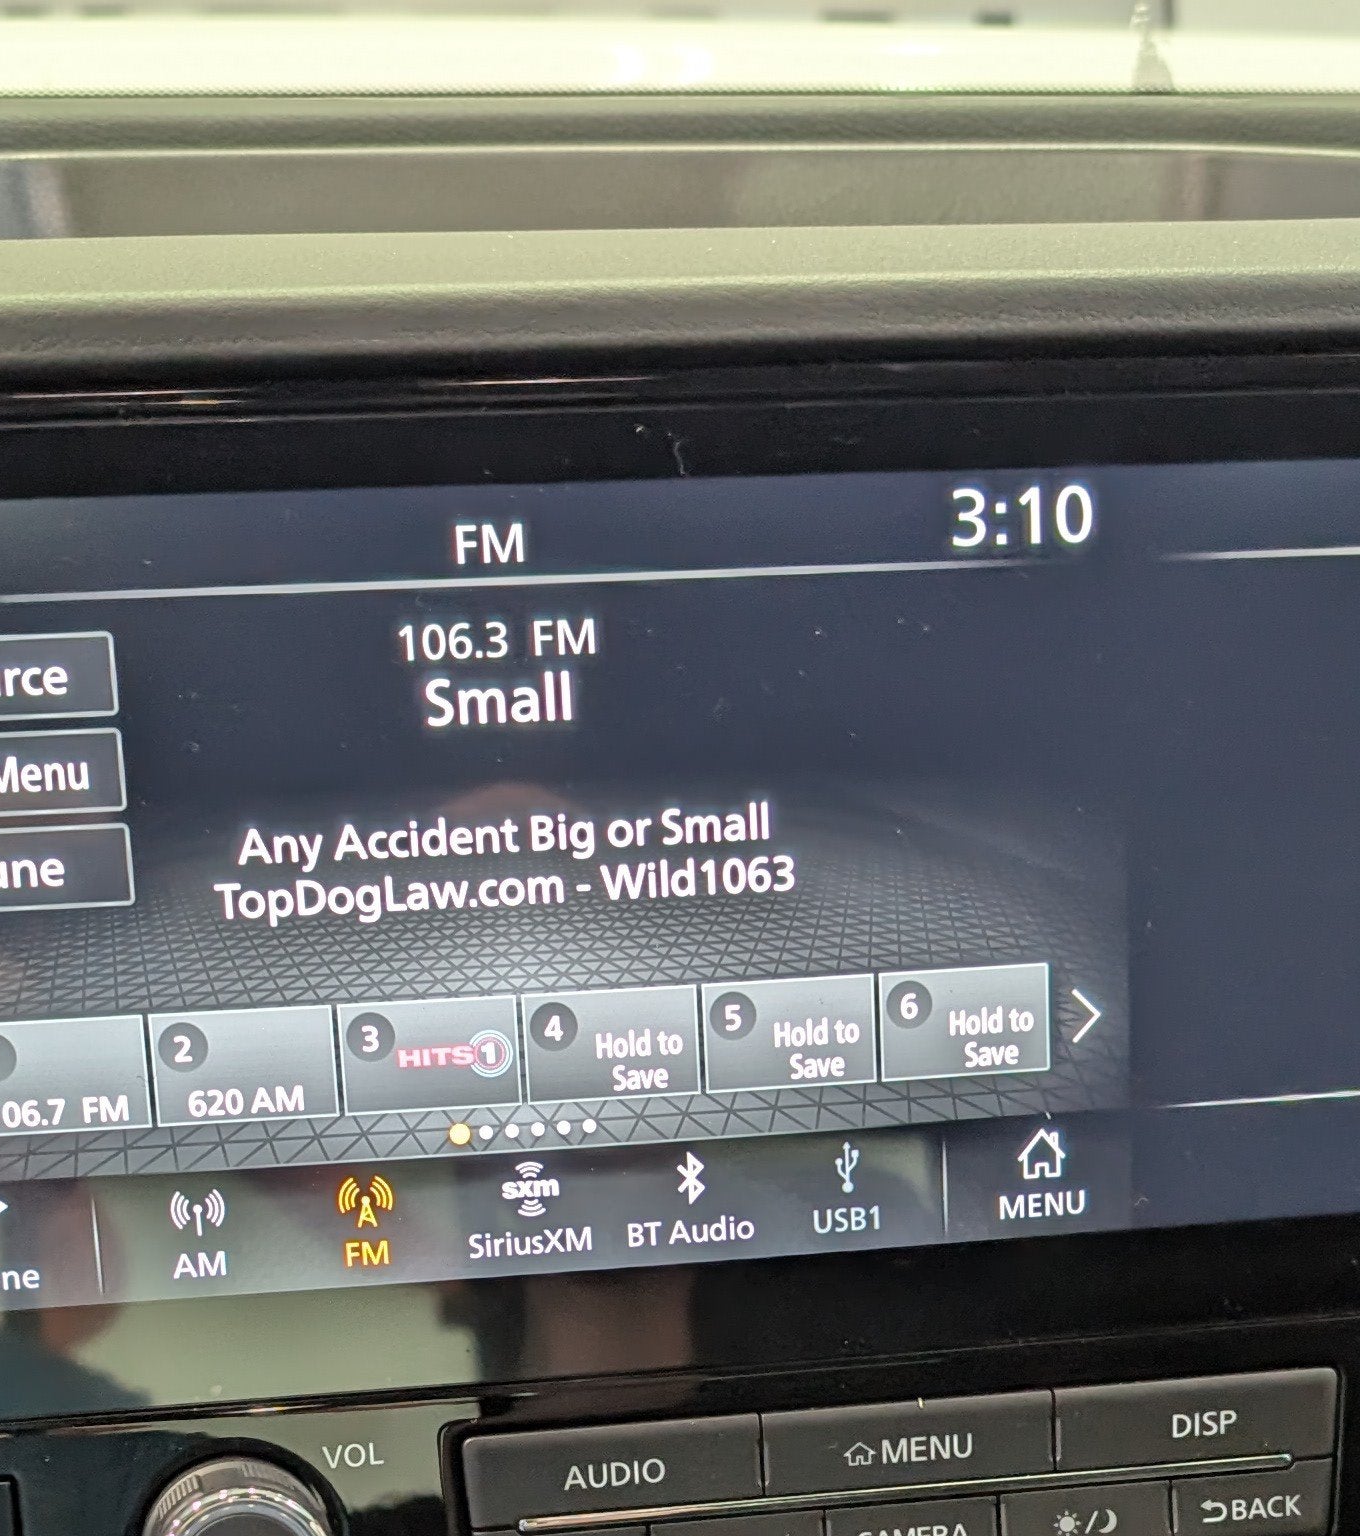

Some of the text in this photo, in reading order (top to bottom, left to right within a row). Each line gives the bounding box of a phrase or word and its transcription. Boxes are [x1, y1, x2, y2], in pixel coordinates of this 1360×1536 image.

[951, 485, 1093, 548] 3:10
[455, 523, 526, 565] FM
[398, 618, 596, 662] 106.3 FM
[424, 670, 573, 727] Small
[238, 801, 770, 873] Any Accident Big or Small
[214, 855, 796, 926] TopDogLaw.com - Wild1063
[724, 1004, 742, 1032] 5
[900, 992, 918, 1020] 6
[544, 1015, 564, 1042] 4
[773, 1019, 860, 1049] Hold to
[948, 1008, 1035, 1037] Hold to
[172, 1036, 193, 1064] 2
[361, 1025, 380, 1053] 3
[595, 1031, 683, 1060] Hold to
[397, 1045, 476, 1068] HITS
[789, 1053, 845, 1080] Save
[964, 1041, 1019, 1068] Save
[612, 1064, 669, 1092] Save
[82, 1096, 131, 1124] FM
[188, 1085, 305, 1118] 620 AM
[502, 1179, 560, 1199] sxm
[999, 1190, 1085, 1220] MENU
[627, 1215, 755, 1247] BT Audio
[813, 1206, 881, 1234] USB1
[344, 1241, 391, 1267] FM
[468, 1226, 593, 1259] SiriusXM
[173, 1251, 227, 1280] AM
[1172, 1410, 1237, 1439] DISP
[322, 1442, 384, 1469] VOL
[881, 1433, 974, 1465] MENU
[564, 1458, 665, 1492] AUDIO
[1231, 1494, 1302, 1522] BACK
